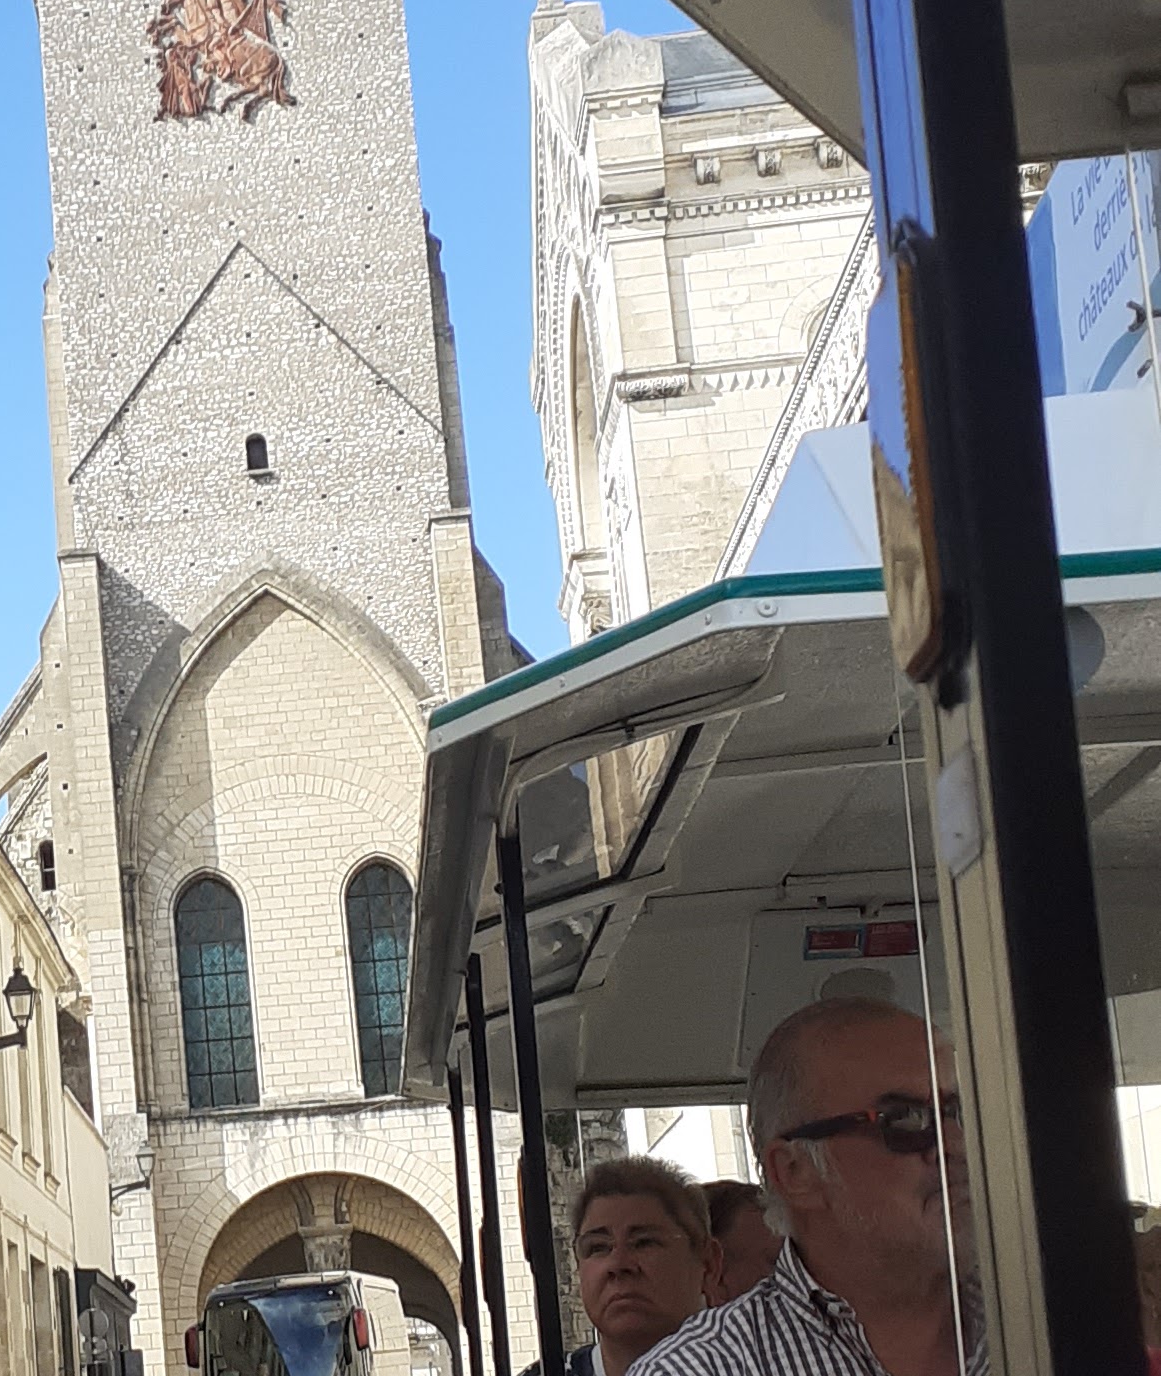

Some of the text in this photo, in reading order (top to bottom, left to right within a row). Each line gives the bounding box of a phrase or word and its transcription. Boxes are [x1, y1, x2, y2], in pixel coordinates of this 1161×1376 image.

[1070, 156, 1102, 226] La vie
[1077, 243, 1129, 342] châteaux
